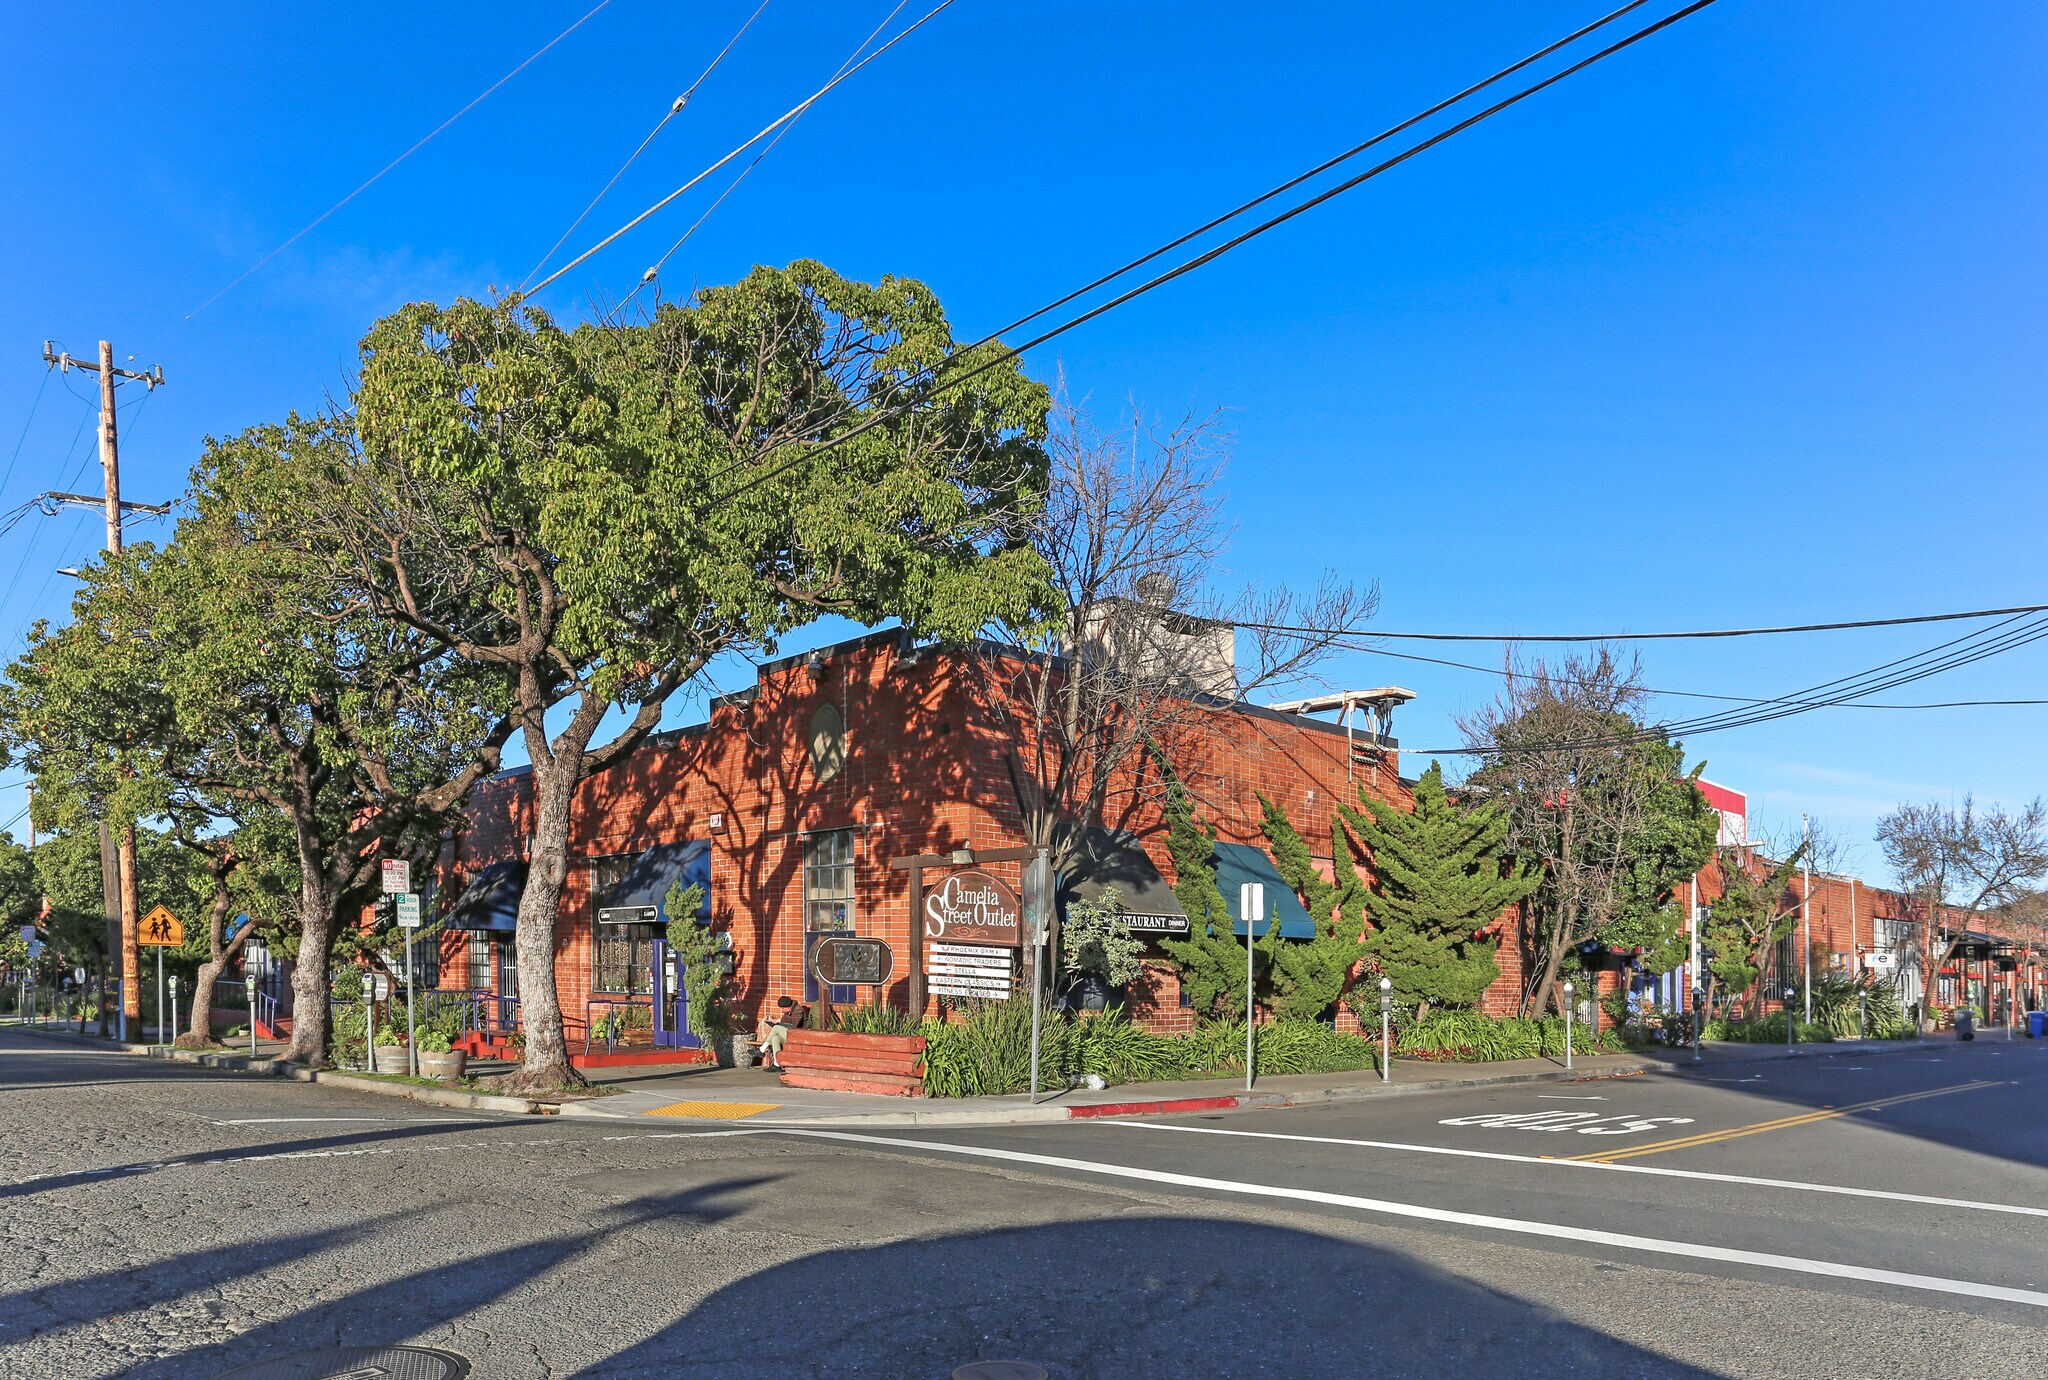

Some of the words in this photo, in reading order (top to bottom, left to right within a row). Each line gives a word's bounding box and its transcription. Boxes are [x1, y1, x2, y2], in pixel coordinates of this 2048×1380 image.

[383, 862, 392, 870] NO
[944, 877, 999, 911] Camelia
[398, 895, 405, 904] 2
[926, 894, 973, 937] Street
[974, 903, 1017, 928] Outlet
[1117, 915, 1167, 928] STAURANT
[950, 946, 979, 954] PHOENIX
[944, 956, 973, 964] NOMADIC
[974, 957, 1002, 966] TRADERS
[954, 967, 977, 975] STELLA
[935, 976, 963, 985] EASTERN
[964, 978, 995, 987] CLASSICS
[938, 987, 963, 995] FITNESS
